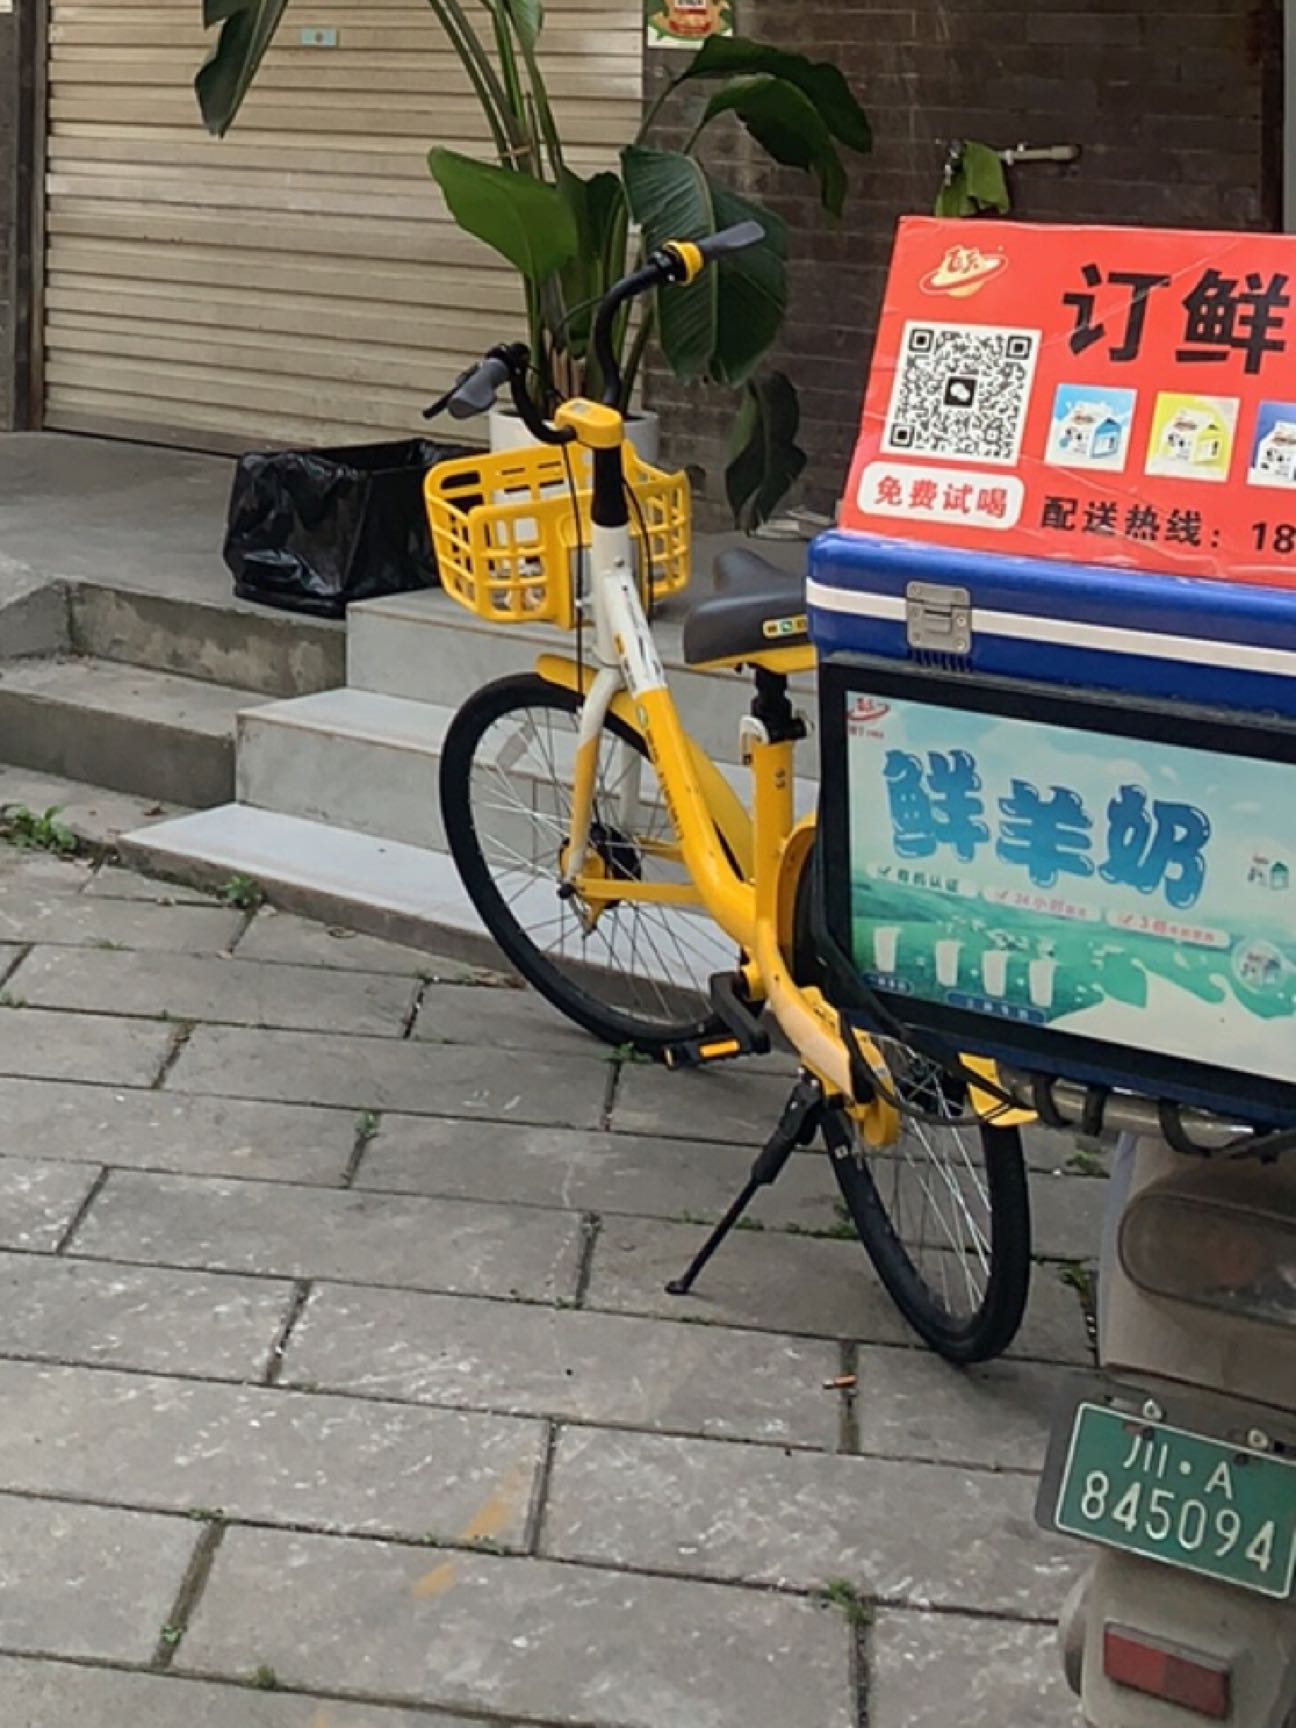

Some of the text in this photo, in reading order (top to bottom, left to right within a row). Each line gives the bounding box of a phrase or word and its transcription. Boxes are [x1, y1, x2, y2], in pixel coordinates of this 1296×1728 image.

[1062, 262, 1293, 376] 订鲜
[873, 474, 1009, 520] 免费试喝
[882, 747, 1212, 911] 鲜羊奶
[1080, 1470, 1276, 1573] 845094
